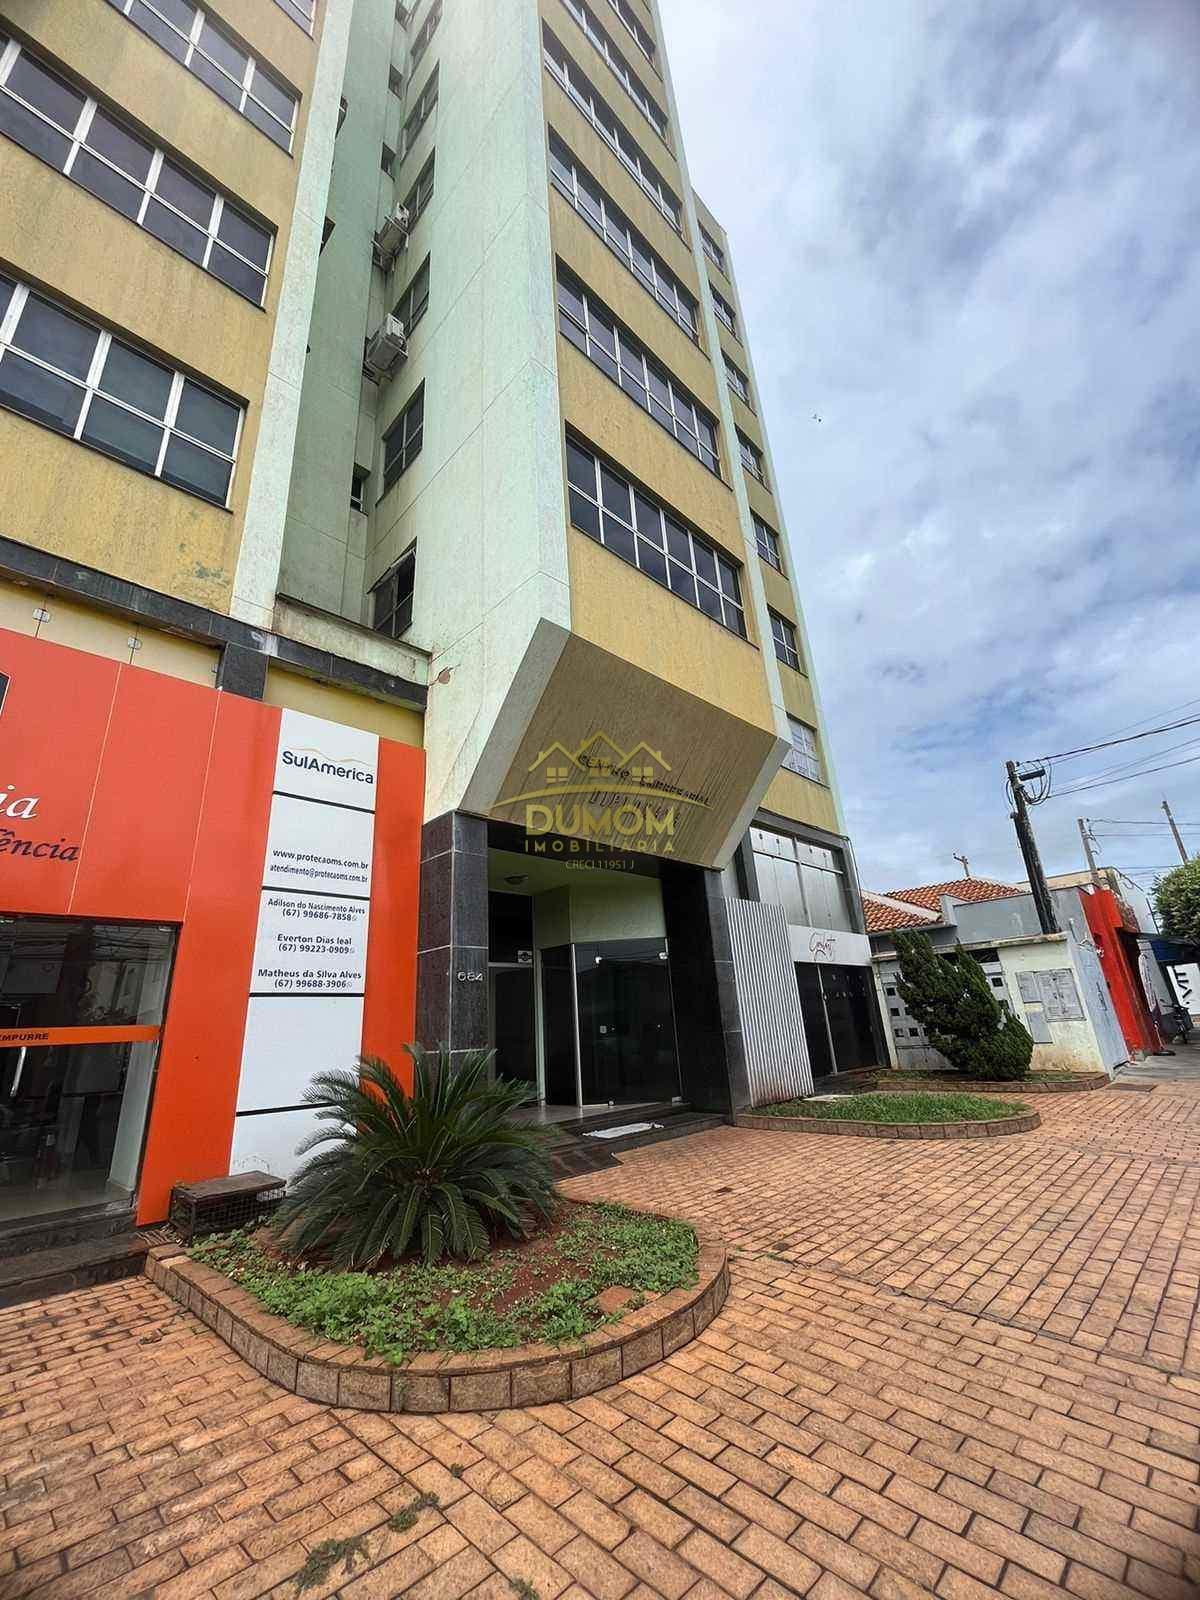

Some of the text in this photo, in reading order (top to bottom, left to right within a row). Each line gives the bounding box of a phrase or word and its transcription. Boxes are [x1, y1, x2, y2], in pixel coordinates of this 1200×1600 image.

[282, 751, 374, 784] SulAmerica
[273, 849, 368, 869] www.protecaoms.com.br
[270, 864, 368, 883] atendimento@protecaoms.com.br
[268, 898, 365, 914] Adilson do Nascimento Alves
[282, 908, 351, 921] (67) 99686-7858
[277, 934, 312, 944] Everton
[316, 936, 334, 945] Dias
[278, 944, 350, 955] (67) 99223-0909
[258, 969, 361, 980] Matheus da Silva Alves
[274, 979, 347, 989] (67) 99688-3906
[0, 1032, 49, 1041] MPURRE
